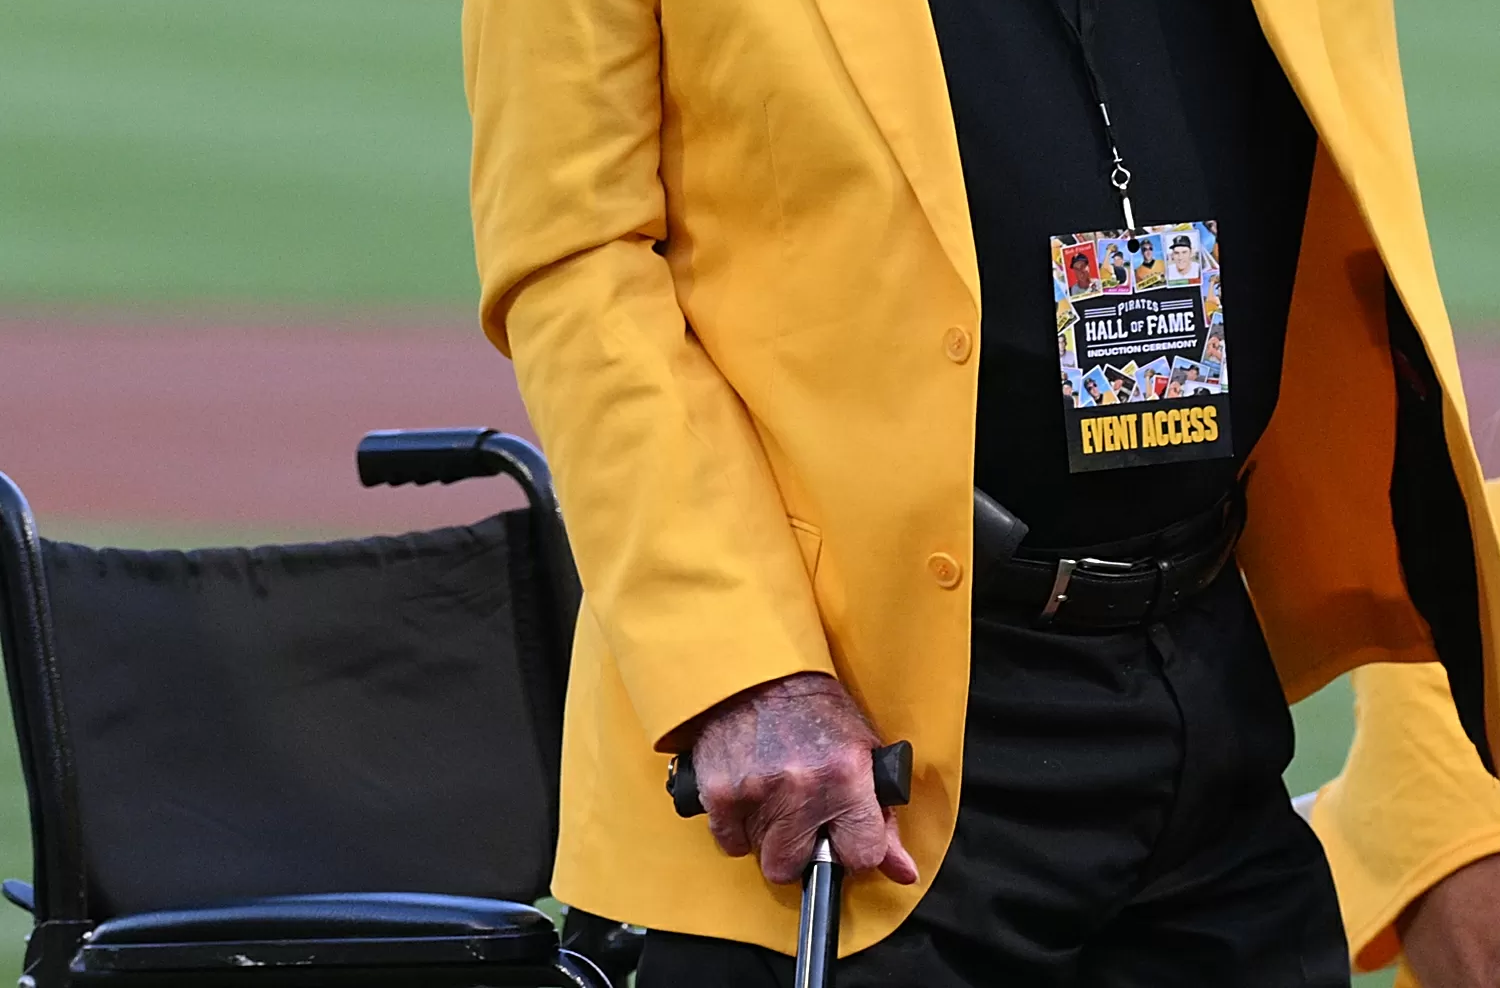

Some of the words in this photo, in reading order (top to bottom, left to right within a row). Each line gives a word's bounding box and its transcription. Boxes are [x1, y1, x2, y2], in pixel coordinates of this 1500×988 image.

[1117, 298, 1159, 316] PIRATES
[1085, 318, 1129, 342] HALL
[1130, 320, 1145, 333] OF
[1146, 311, 1195, 336] FAME
[1087, 344, 1142, 358] INDUCTION
[1142, 339, 1198, 352] CEREMONY
[1080, 413, 1138, 454] EVENT
[1142, 405, 1218, 448] ACCESS
